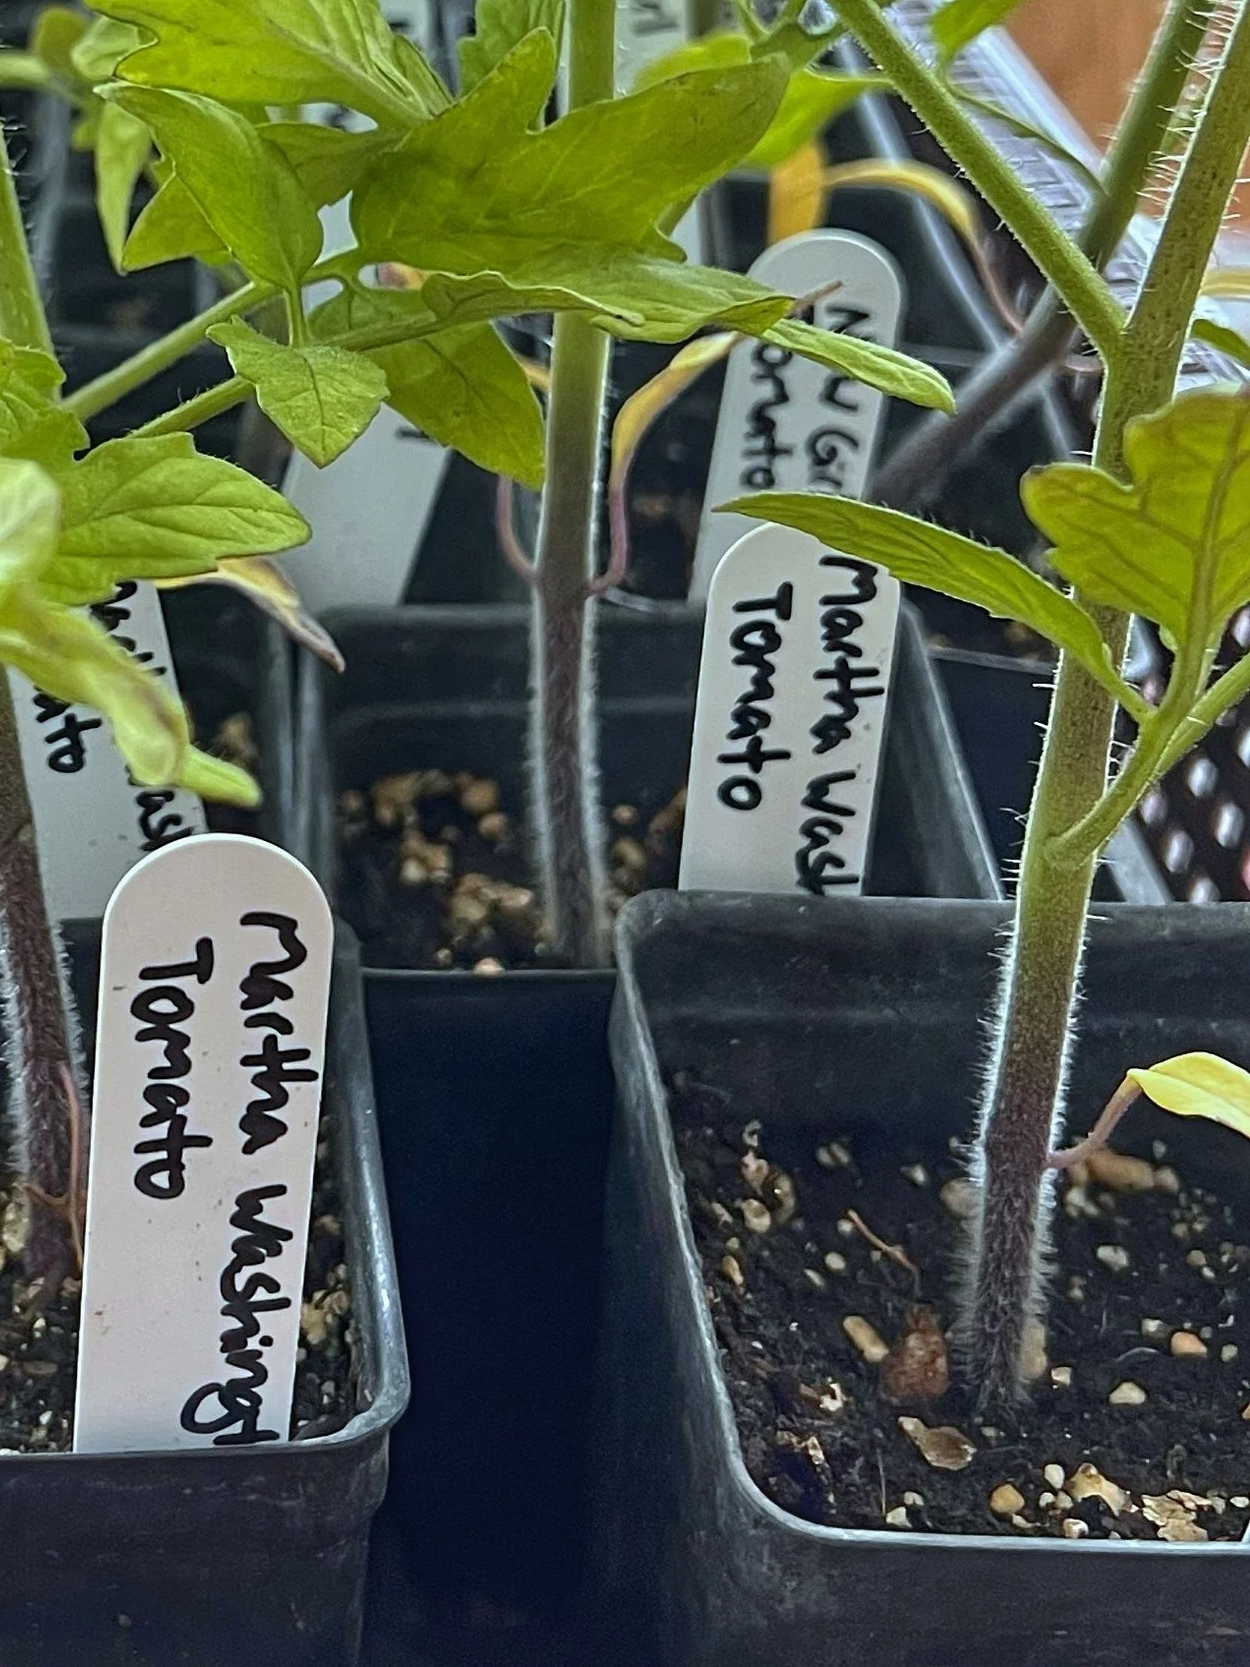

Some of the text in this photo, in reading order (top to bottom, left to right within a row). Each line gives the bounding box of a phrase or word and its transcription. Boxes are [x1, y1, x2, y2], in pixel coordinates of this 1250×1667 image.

[717, 582, 793, 812] Tomato
[810, 555, 885, 754] Martha
[130, 936, 214, 1200] Tomato
[239, 911, 318, 1154] Martha
